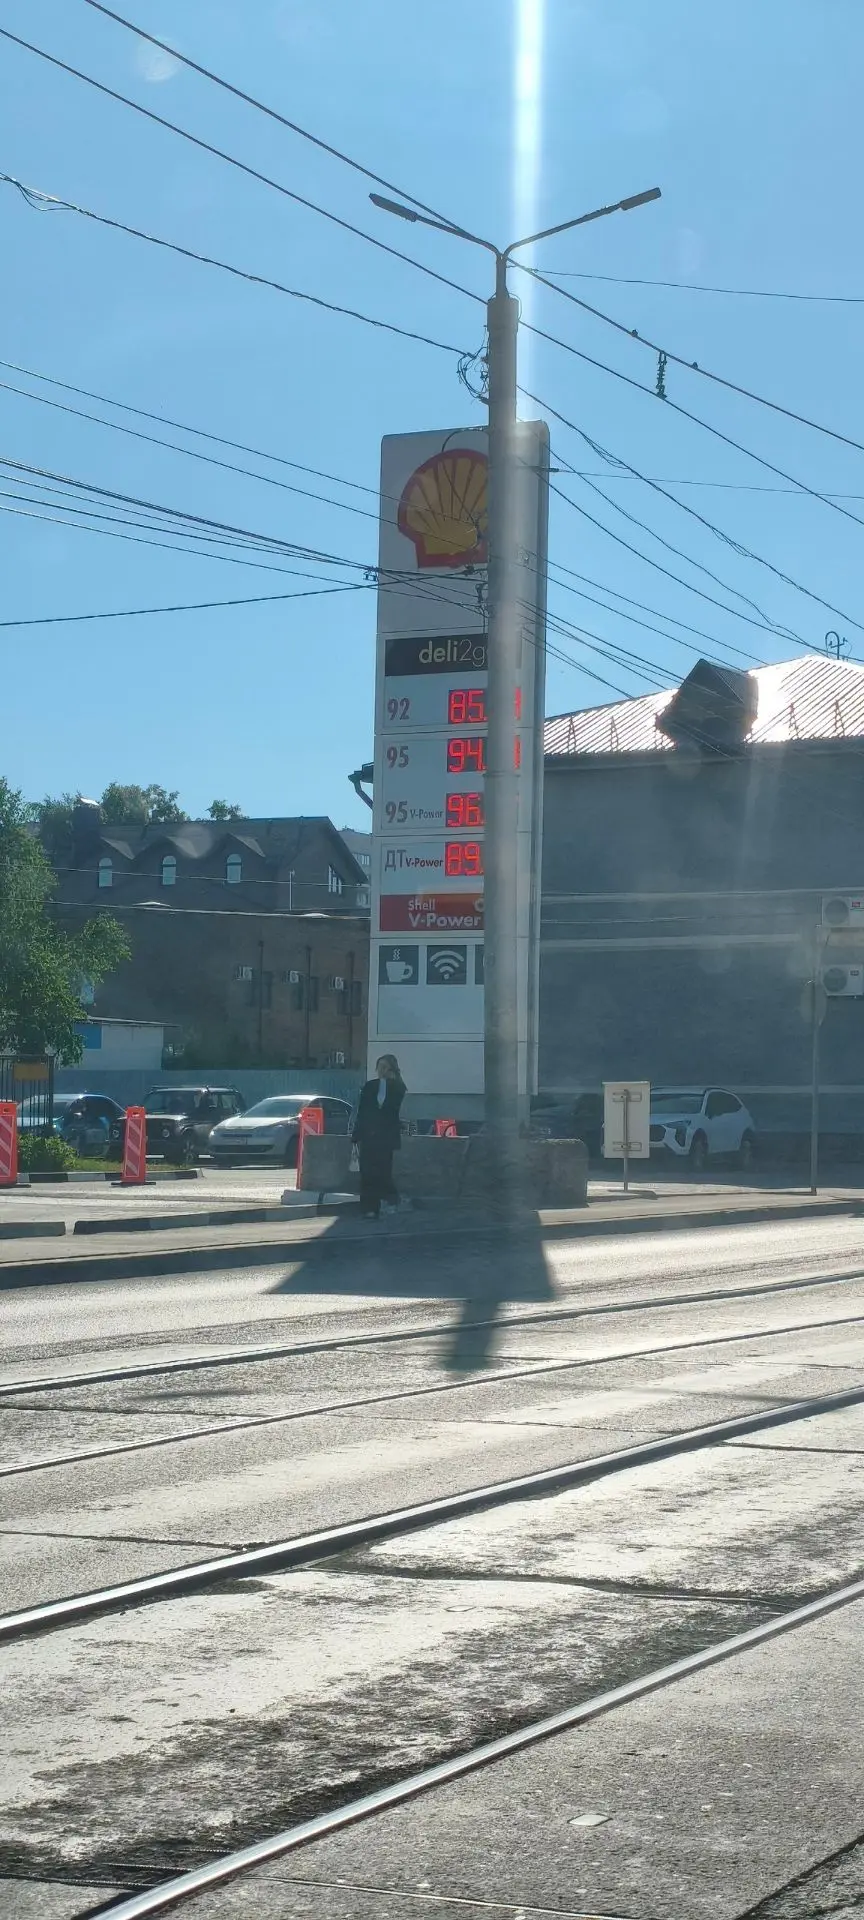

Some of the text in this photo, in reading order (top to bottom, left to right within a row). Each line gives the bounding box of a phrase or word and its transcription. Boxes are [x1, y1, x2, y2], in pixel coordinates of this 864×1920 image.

[419, 639, 488, 667] deli2g
[387, 697, 410, 720] 92
[386, 745, 409, 768] 95
[385, 800, 408, 823] 95
[385, 849, 406, 872] ДТ
[405, 857, 443, 868] V-Power
[409, 913, 481, 928] V-Power
